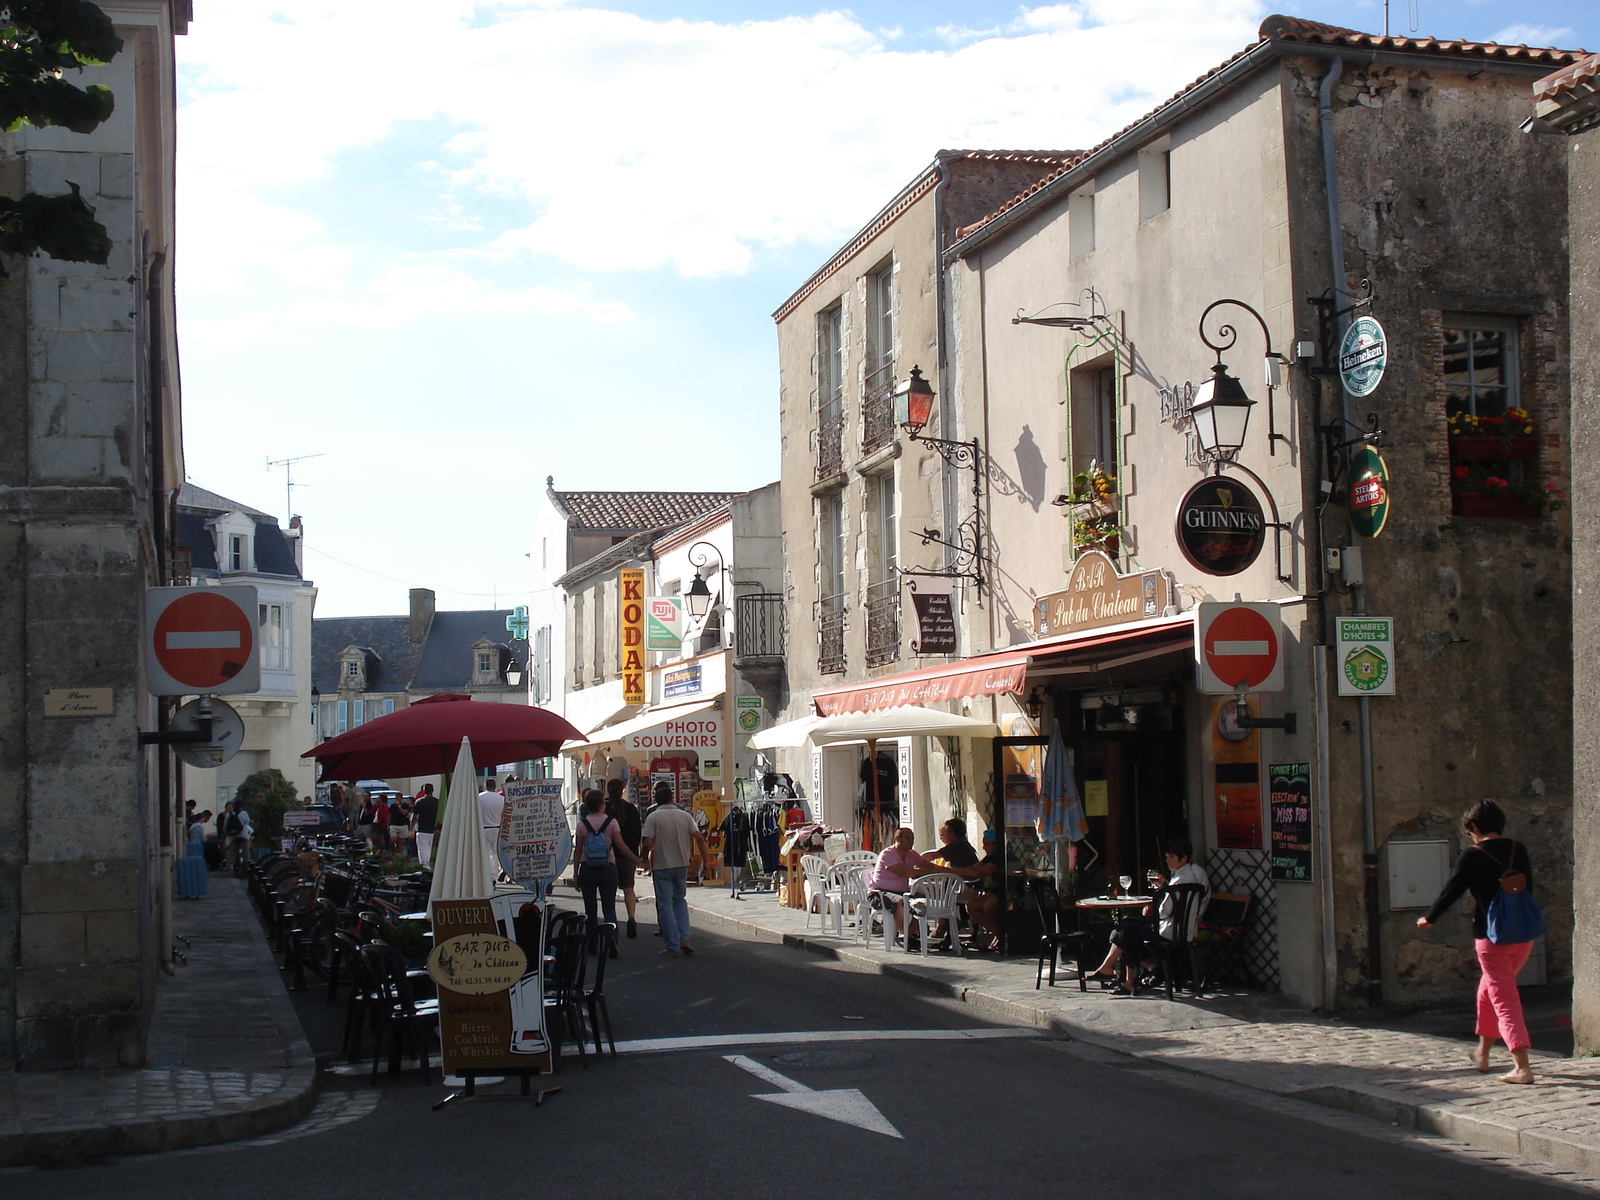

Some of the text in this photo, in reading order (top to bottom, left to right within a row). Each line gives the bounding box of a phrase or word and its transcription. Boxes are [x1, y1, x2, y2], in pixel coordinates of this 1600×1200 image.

[1343, 346, 1382, 369] Heineken
[1159, 380, 1193, 425] BAR
[1355, 491, 1380, 505] ARTOIS
[1185, 507, 1260, 530] GUINNESS
[1075, 562, 1106, 592] BAR
[654, 603, 673, 618] FUJI
[1053, 590, 1141, 628] Pub du Château
[1343, 623, 1386, 631] CHAMBRES
[623, 580, 643, 694] KODAK
[1344, 631, 1376, 640] D'HÔTES
[1357, 682, 1368, 690] DE
[1369, 664, 1388, 689] FRANCE
[66, 691, 91, 699] Place
[864, 692, 878, 706] BAR
[60, 703, 98, 711] d'Armes
[666, 721, 717, 733] PHOTO
[633, 735, 717, 748] SOUVENIRS
[1291, 763, 1299, 776] 13
[508, 784, 537, 797] BOISSONS
[515, 843, 547, 856] SNACKS
[437, 907, 489, 925] OUVERT
[453, 941, 510, 956] BAR PUB
[473, 957, 519, 969] du Château
[461, 1023, 491, 1033] Bières
[454, 1035, 499, 1045] Cocktails
[448, 1046, 504, 1057] et Whiskies
